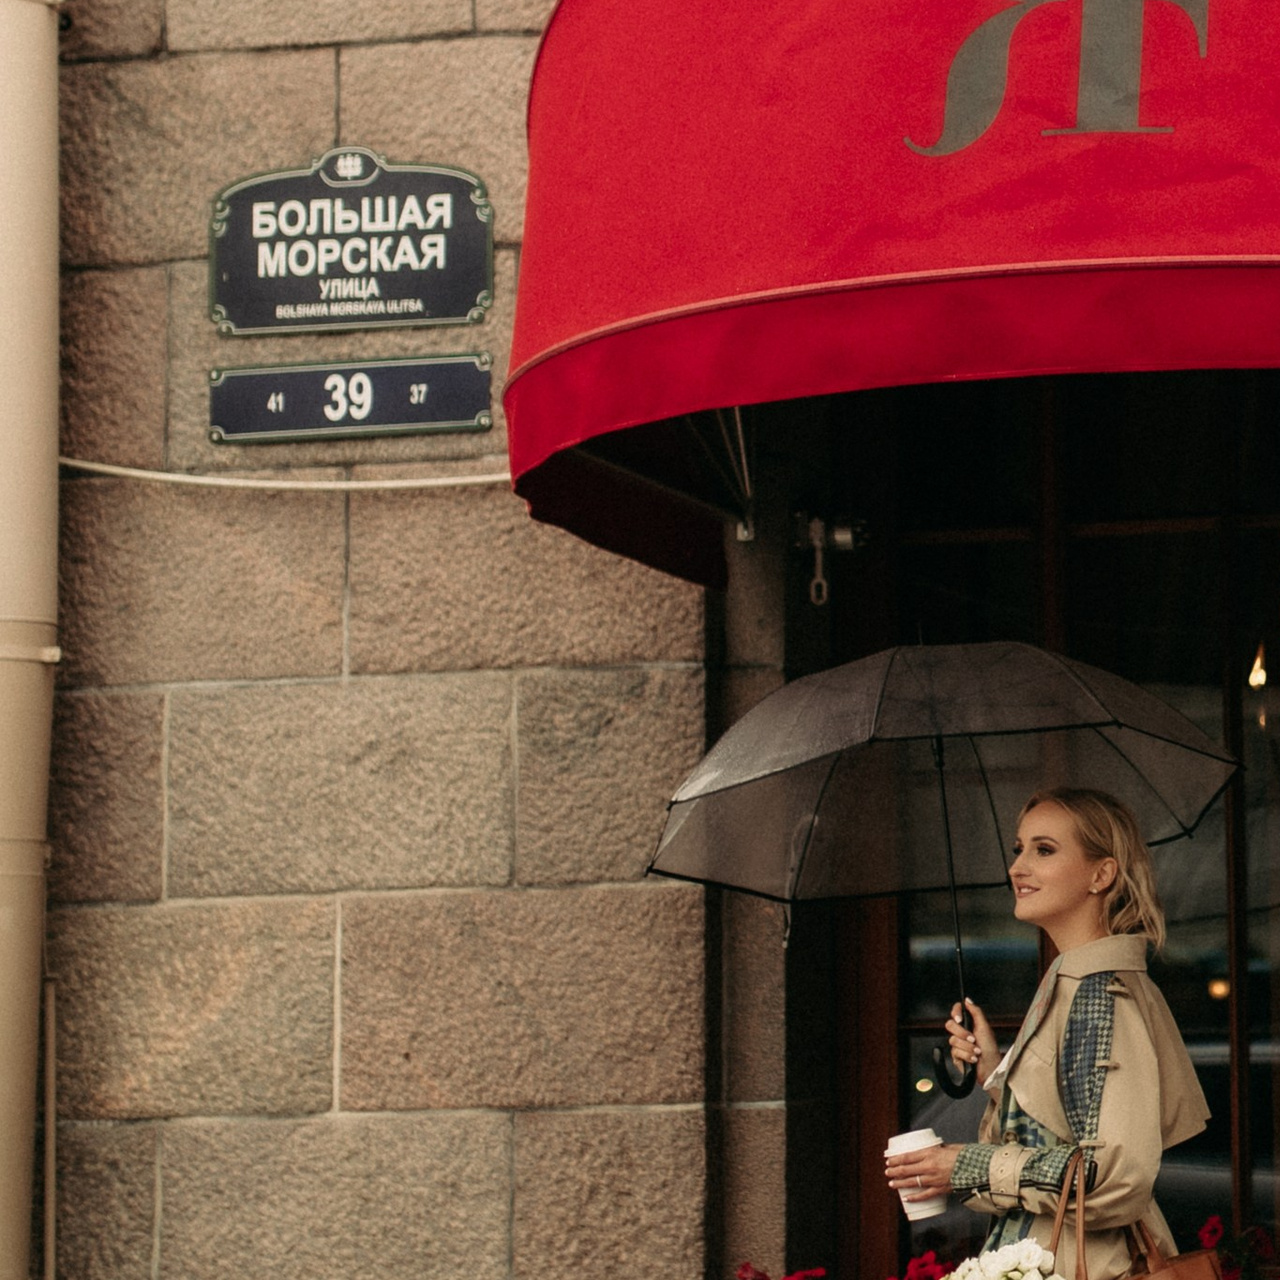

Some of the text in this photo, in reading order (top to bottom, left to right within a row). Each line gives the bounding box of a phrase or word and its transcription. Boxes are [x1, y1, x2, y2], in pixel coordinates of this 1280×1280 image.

[252, 193, 453, 238] БОЛЬШАЯ
[257, 233, 447, 278] МОРСКАЯ
[275, 298, 424, 319] BOLSHAYA MORSKAYA ULITSA
[319, 277, 380, 300] УЛИЦА
[267, 372, 428, 421] 41 39 37
